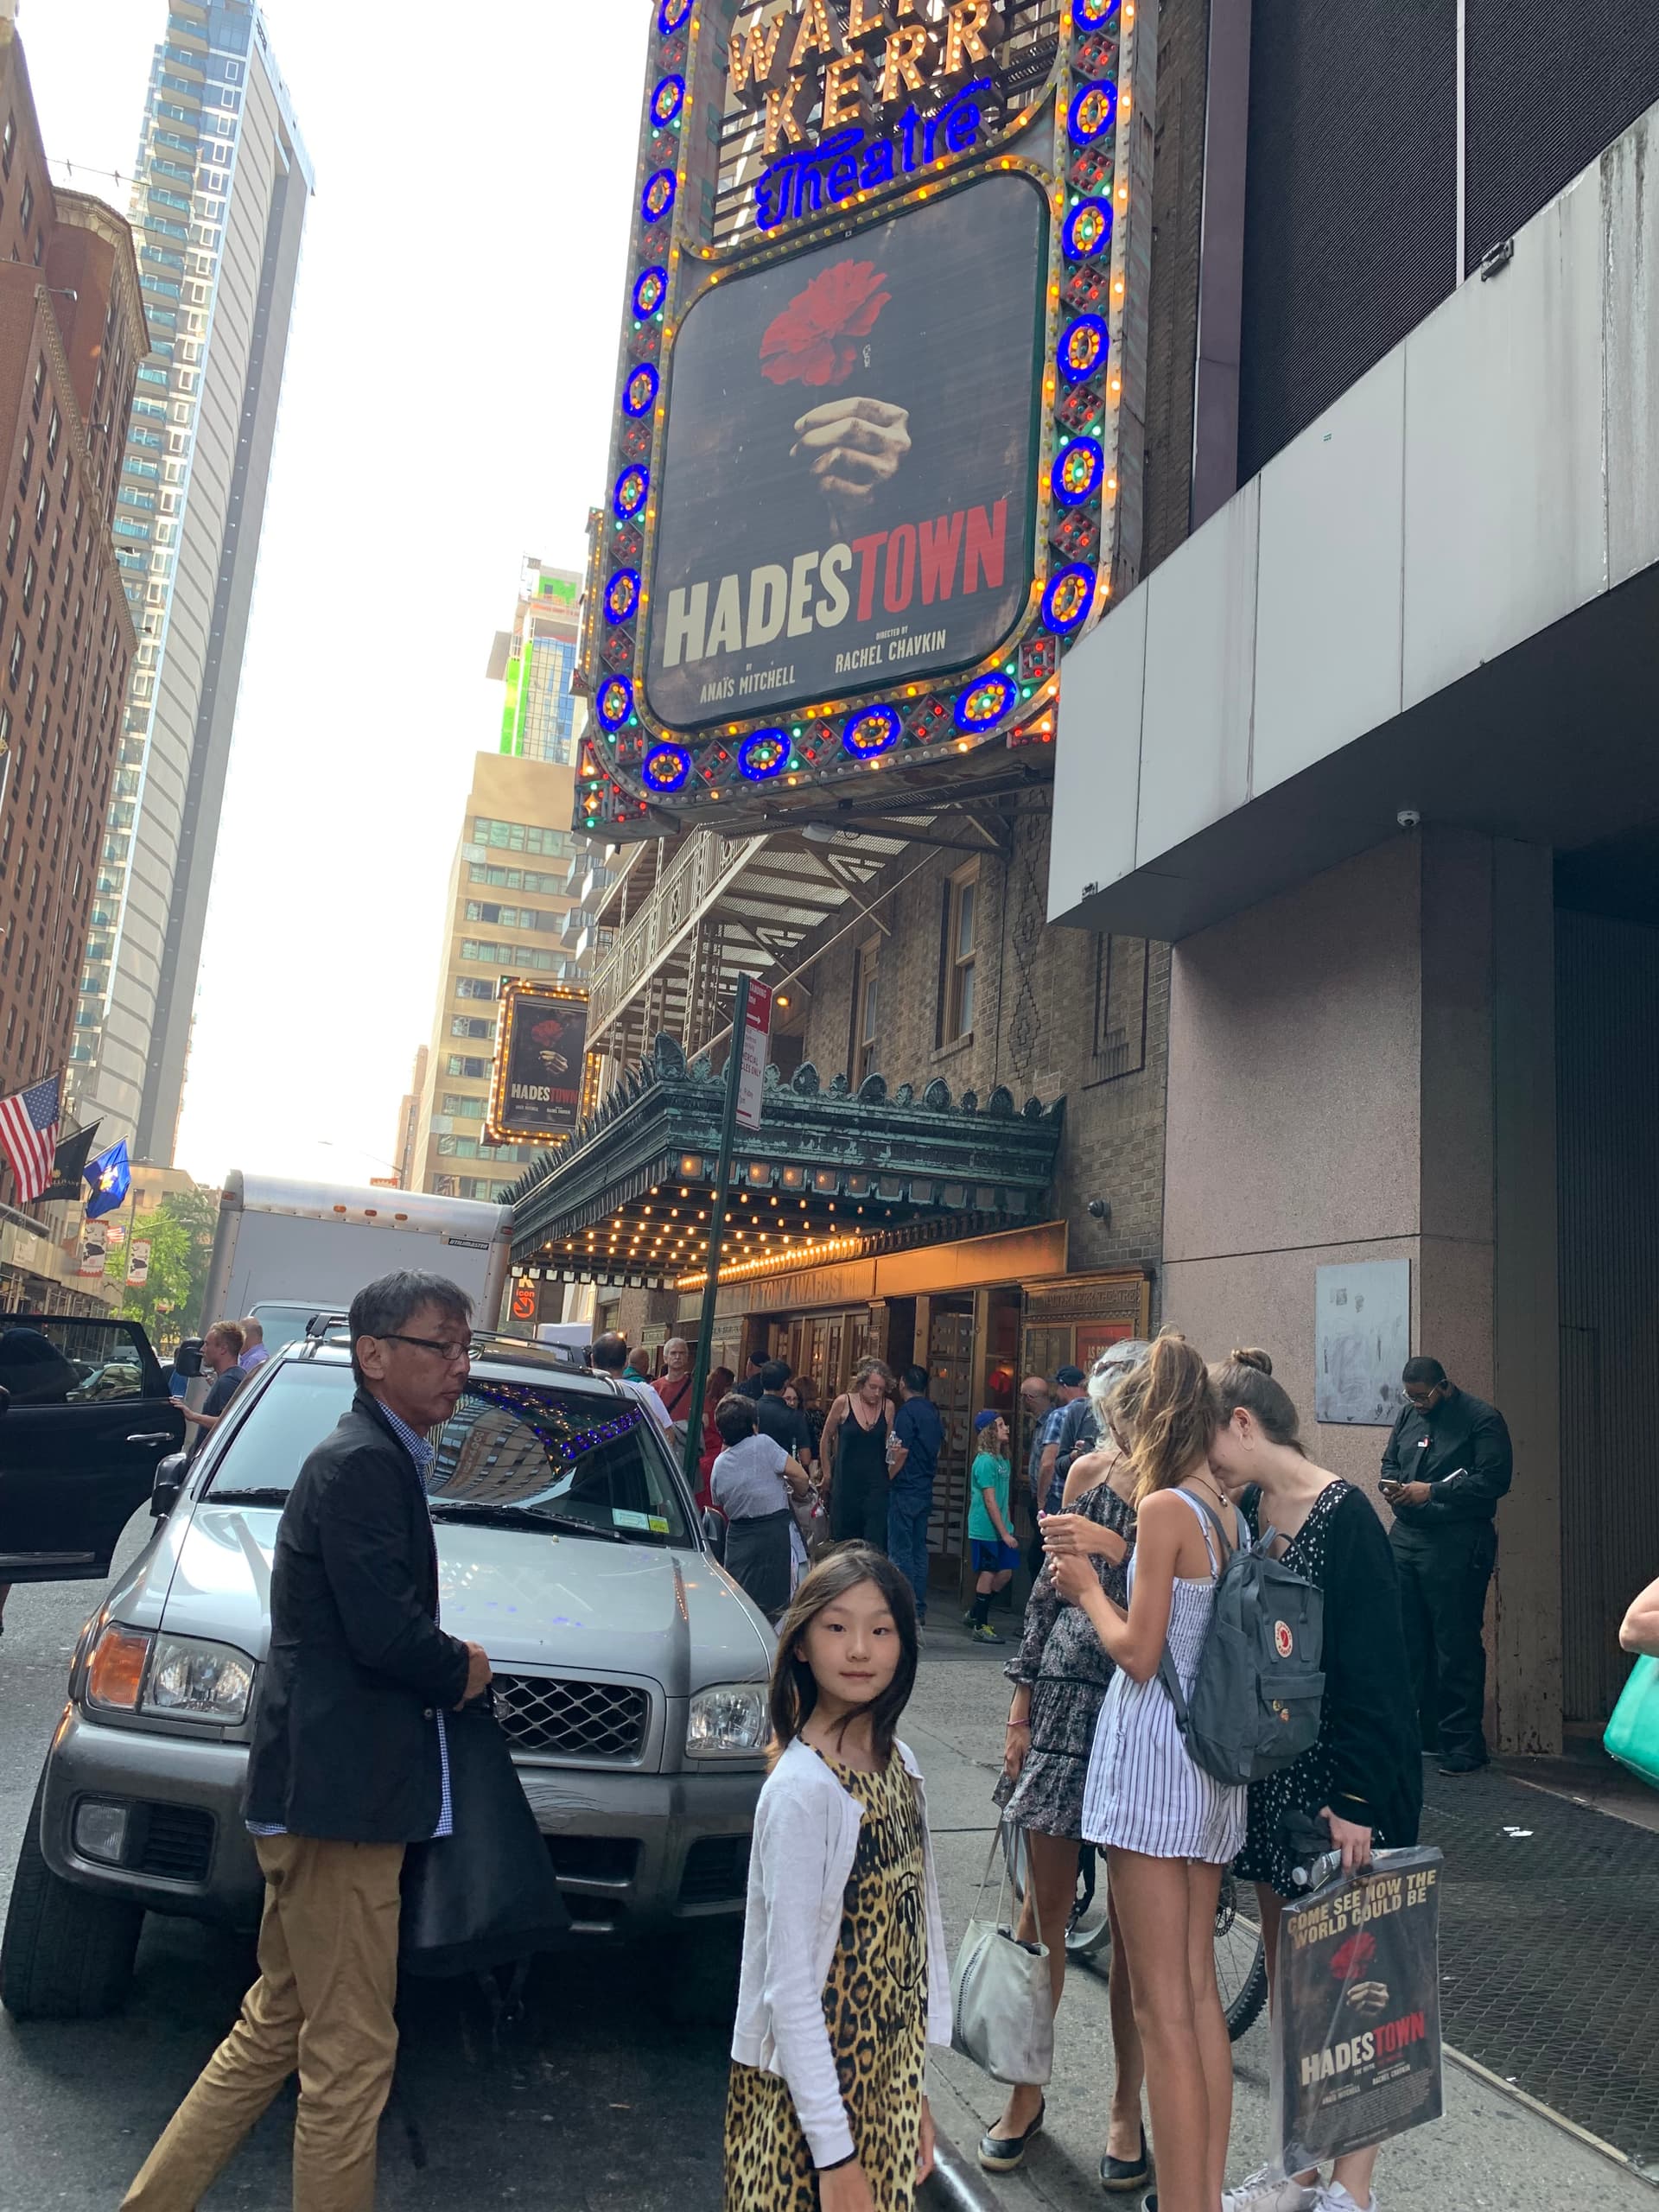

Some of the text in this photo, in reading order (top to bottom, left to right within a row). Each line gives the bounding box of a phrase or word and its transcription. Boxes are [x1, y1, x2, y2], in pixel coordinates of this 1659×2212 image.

[763, 0, 992, 156] KERR
[754, 77, 992, 232] Theatre
[663, 500, 1007, 668] HADESTOWN
[835, 629, 946, 673] RACHEL CHAVKIN
[901, 626, 908, 635] BY
[700, 664, 796, 704] ANAÏS MITCHELL
[511, 1083, 579, 1105] HADESTOWN
[516, 1288, 535, 1297] icon
[1287, 1904, 1329, 1935] COME
[1334, 1890, 1361, 1916] SEE
[1407, 1870, 1437, 1891] THE
[1294, 1887, 1427, 1949] WORLD COULD BE
[1301, 2011, 1425, 2087] HADESTOWN
